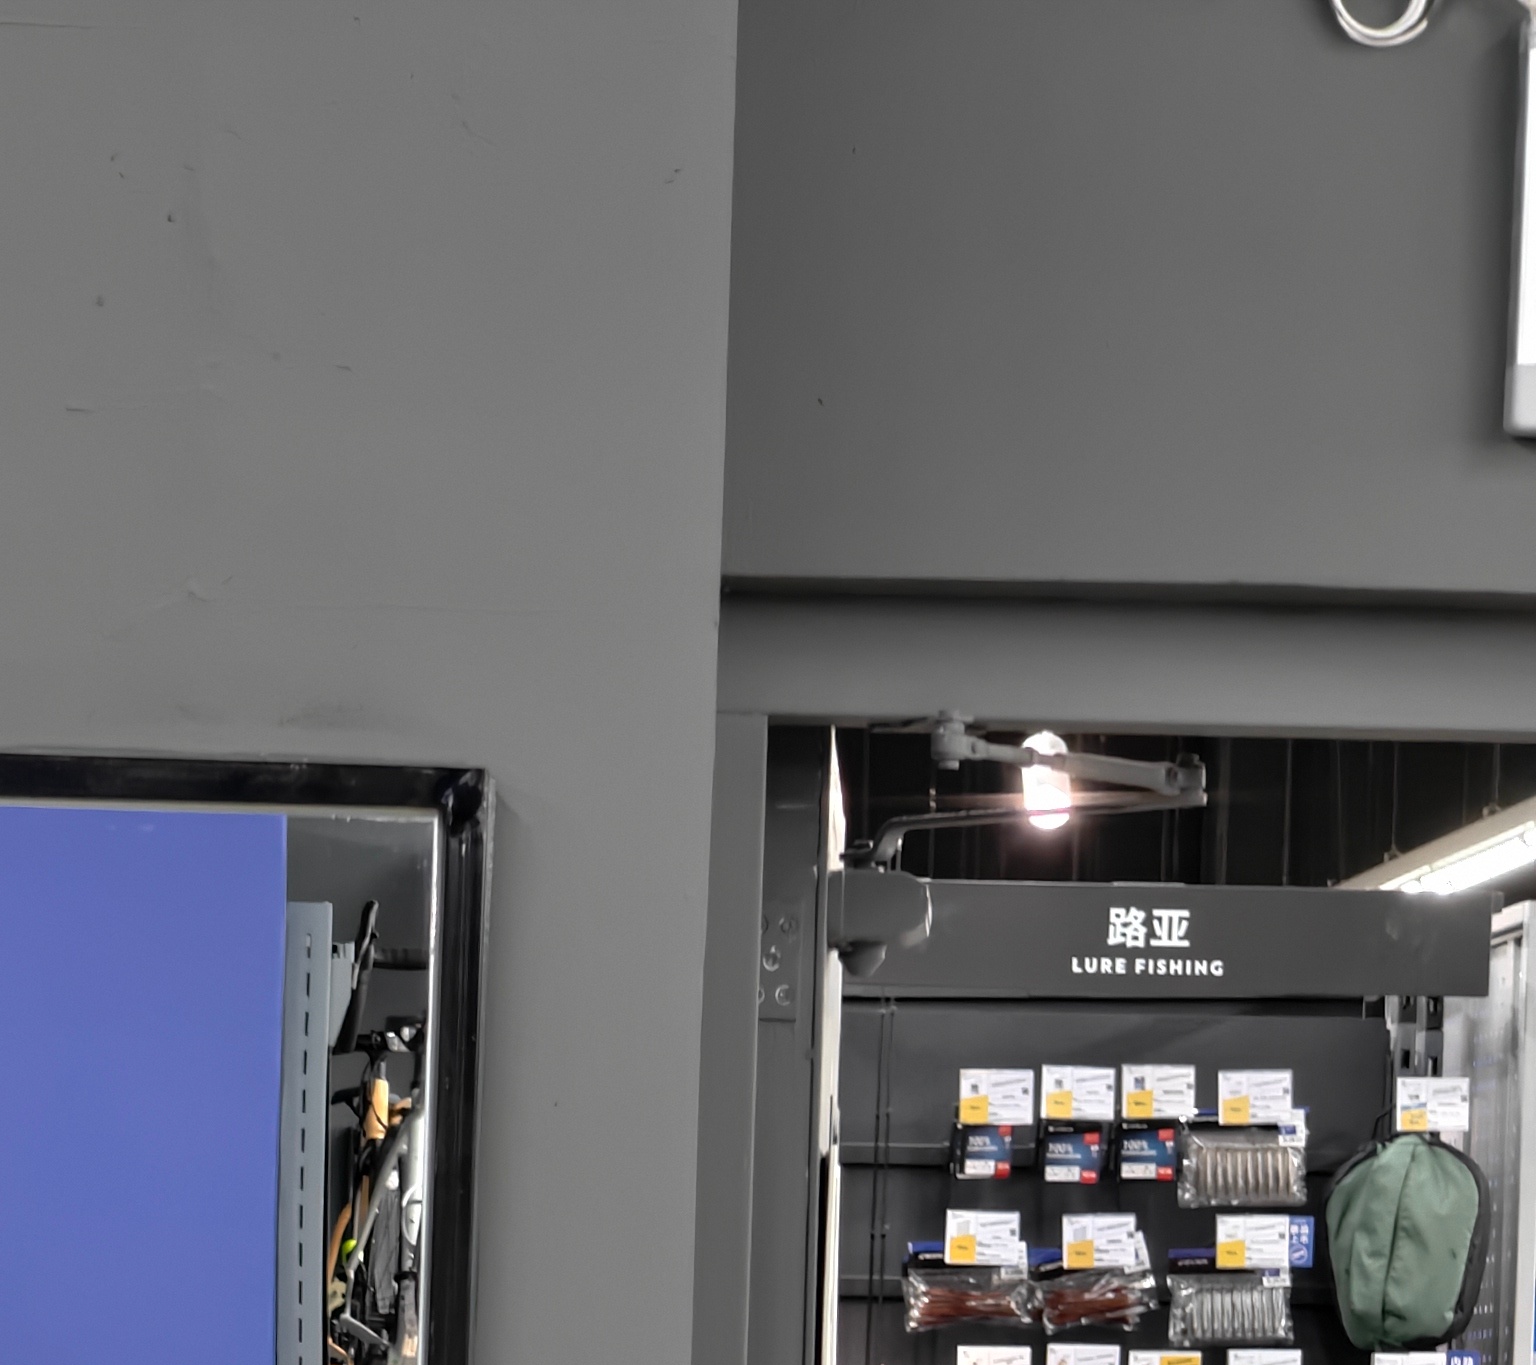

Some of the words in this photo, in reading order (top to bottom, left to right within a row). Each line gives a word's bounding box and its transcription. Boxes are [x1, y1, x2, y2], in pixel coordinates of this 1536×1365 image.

[1106, 906, 1191, 949] 路亚
[1070, 956, 1127, 975] LURE
[1134, 957, 1225, 977] FISHING
